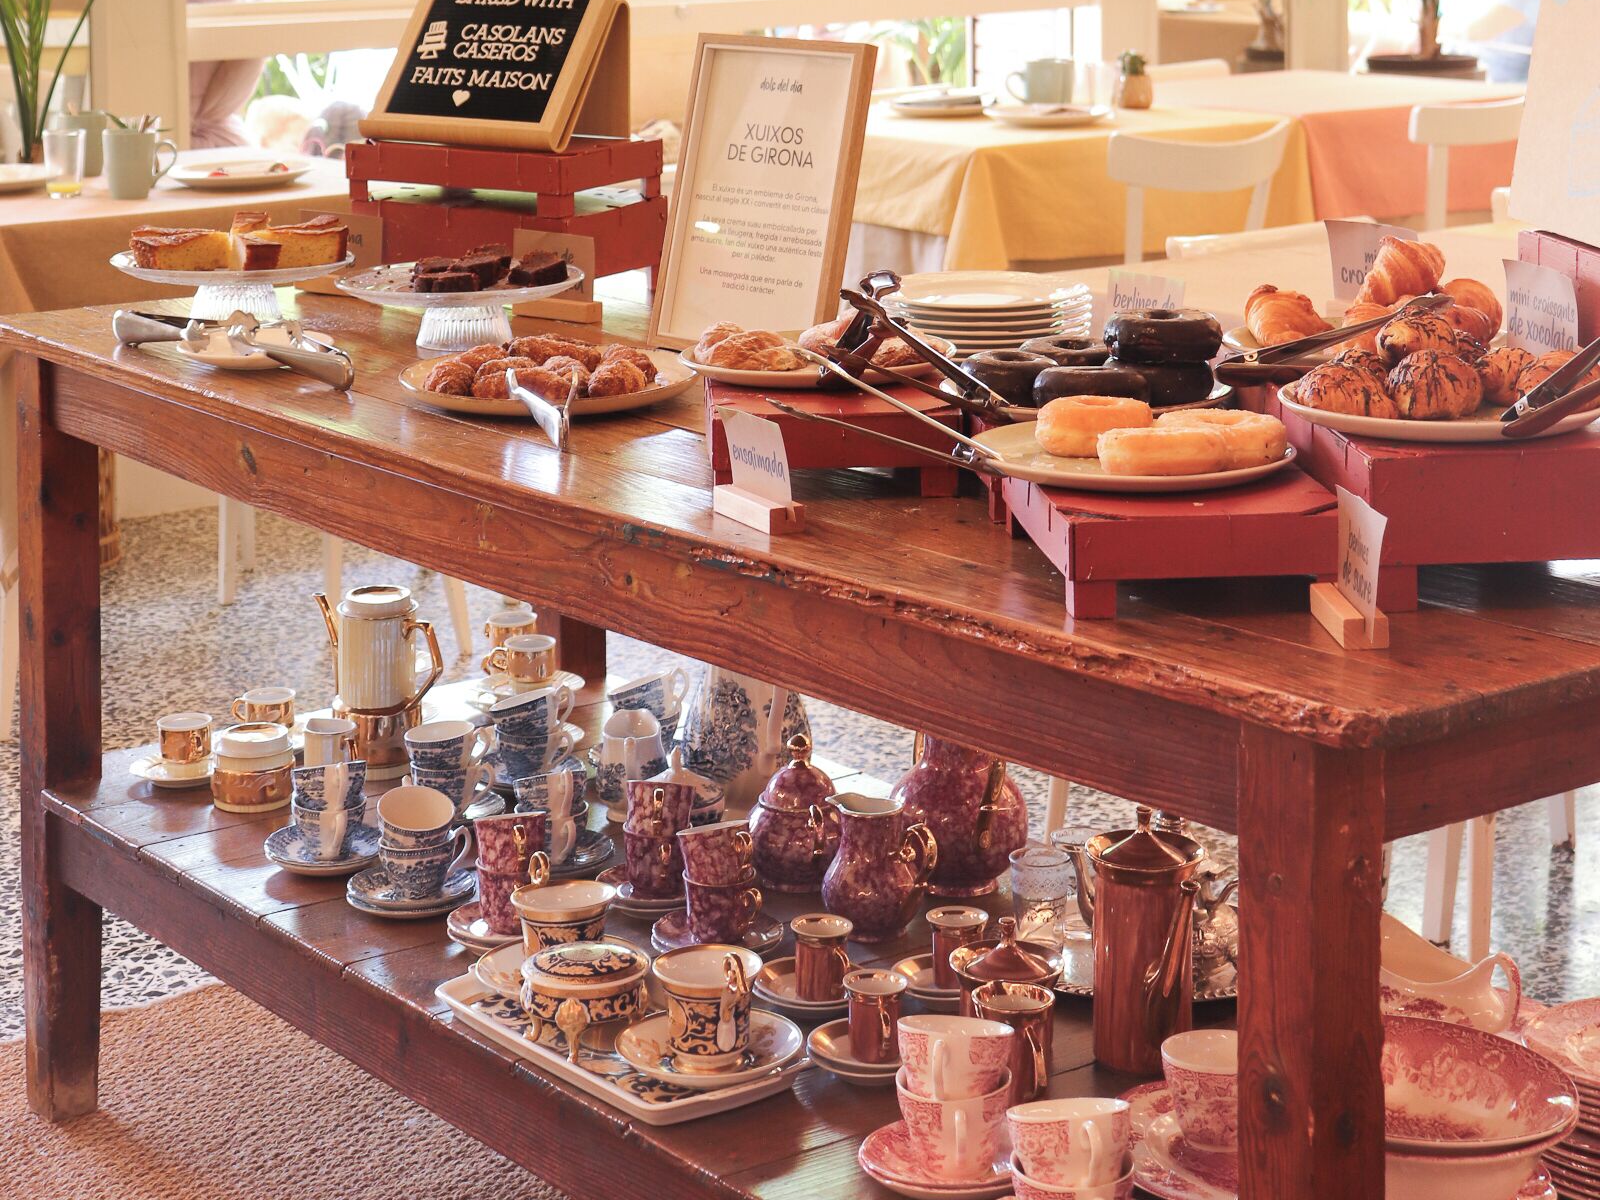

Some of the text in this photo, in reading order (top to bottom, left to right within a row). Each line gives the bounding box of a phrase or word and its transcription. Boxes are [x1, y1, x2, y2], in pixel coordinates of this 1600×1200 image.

[461, 24, 565, 45] CASOLANS
[453, 42, 538, 61] CASEROS
[411, 67, 552, 91] FAITS MAISON
[777, 78, 789, 92] del
[744, 123, 804, 145] XUIXOS
[728, 142, 813, 169] DE GIRONA
[754, 190, 782, 198] emblema
[785, 191, 793, 200] de
[726, 218, 745, 226] crema
[806, 227, 817, 235] per
[756, 232, 778, 242] fregida
[782, 237, 822, 247] arrebossada
[751, 254, 776, 263] paladar.
[700, 267, 711, 275] Una
[713, 270, 749, 281] mossegada
[751, 274, 762, 282] que
[776, 277, 792, 286] parla
[794, 279, 802, 288] de
[1113, 283, 1157, 309] berlines
[1510, 288, 1575, 323] mini croissants
[1509, 308, 1574, 351] de xocolata
[1343, 550, 1371, 604] de sucre
